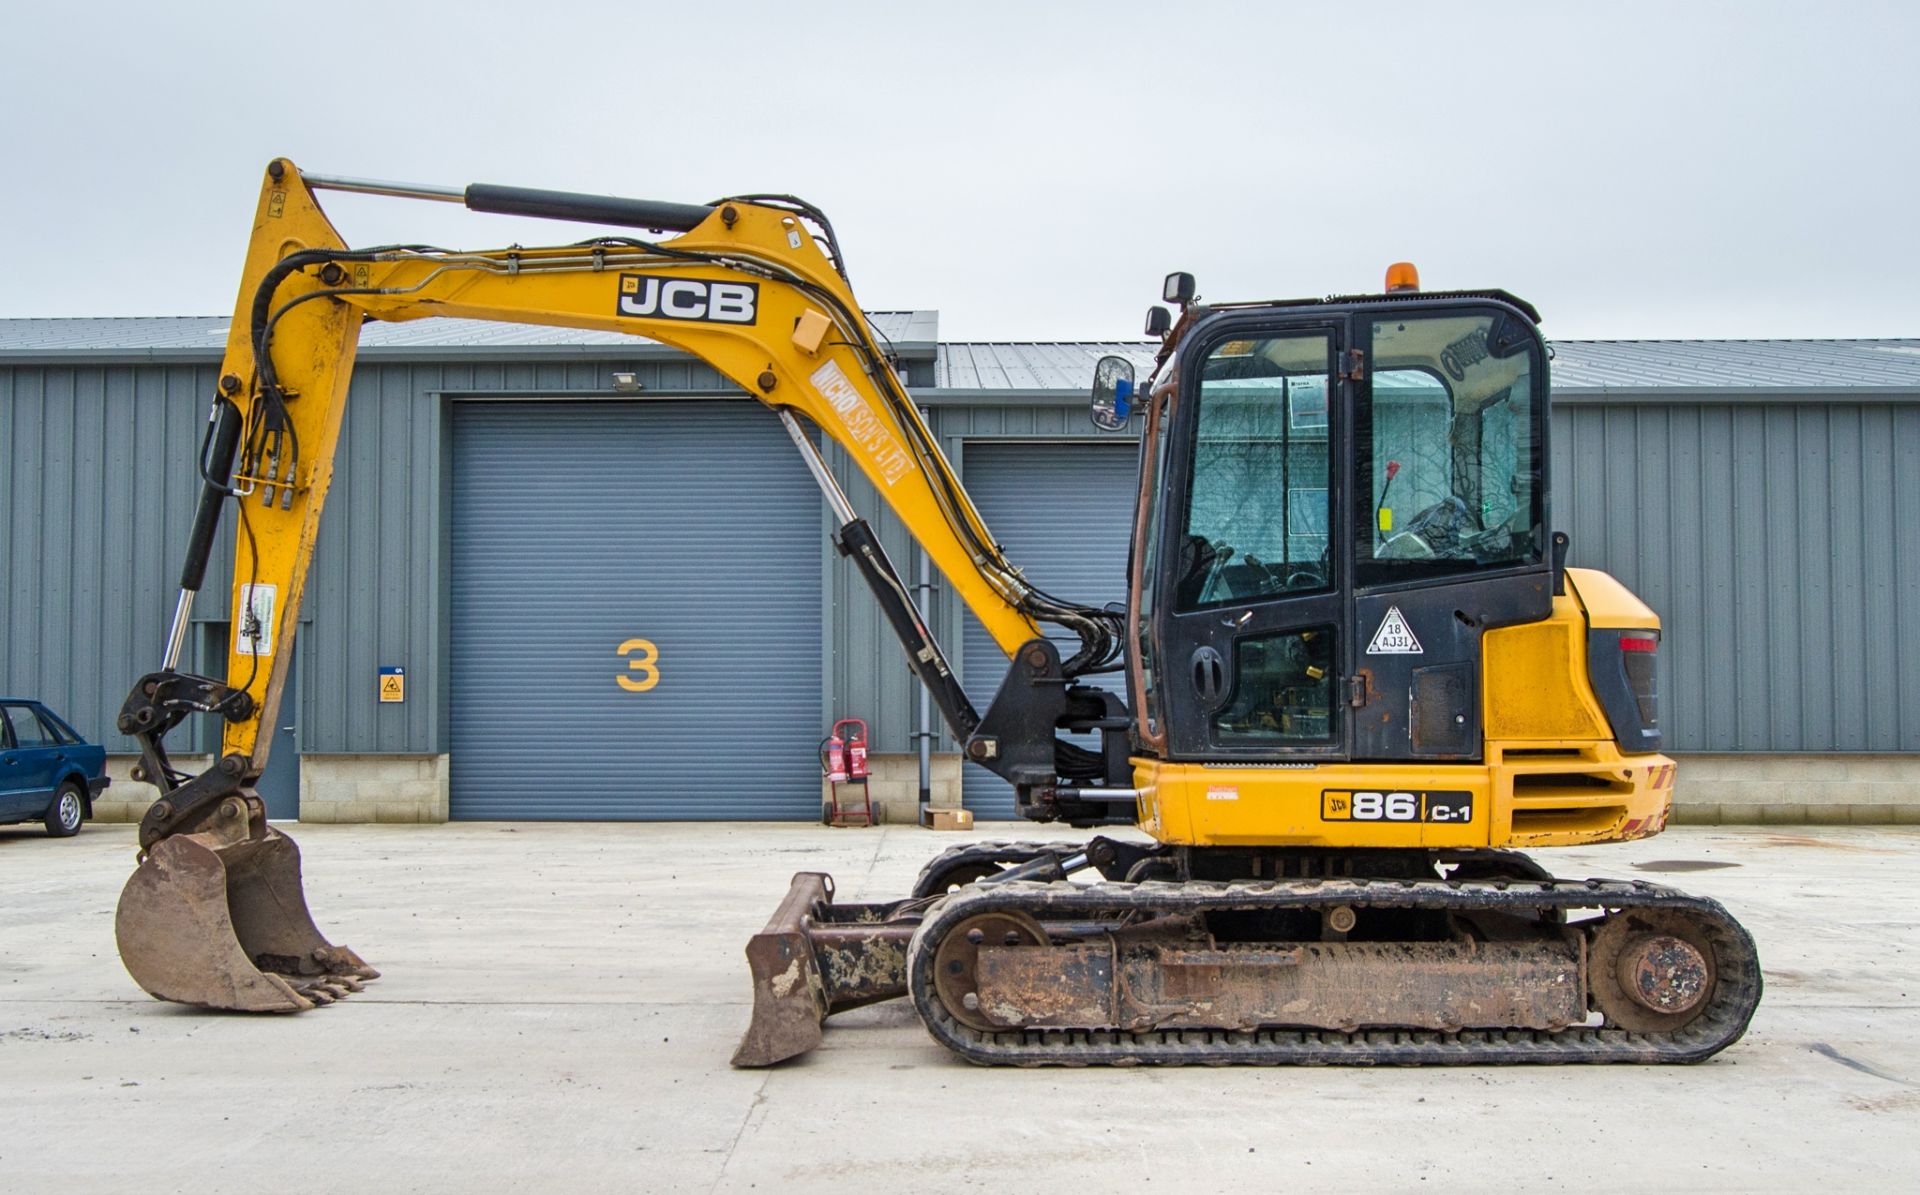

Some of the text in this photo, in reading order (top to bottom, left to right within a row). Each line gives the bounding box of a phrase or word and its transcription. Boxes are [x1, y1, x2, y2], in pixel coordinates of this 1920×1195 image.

[621, 278, 755, 322] JCB
[813, 366, 888, 453] NICHOLSON'S
[1387, 624, 1401, 634] 18
[616, 638, 660, 692] 3
[1331, 792, 1470, 822] JCB 86 C-1
